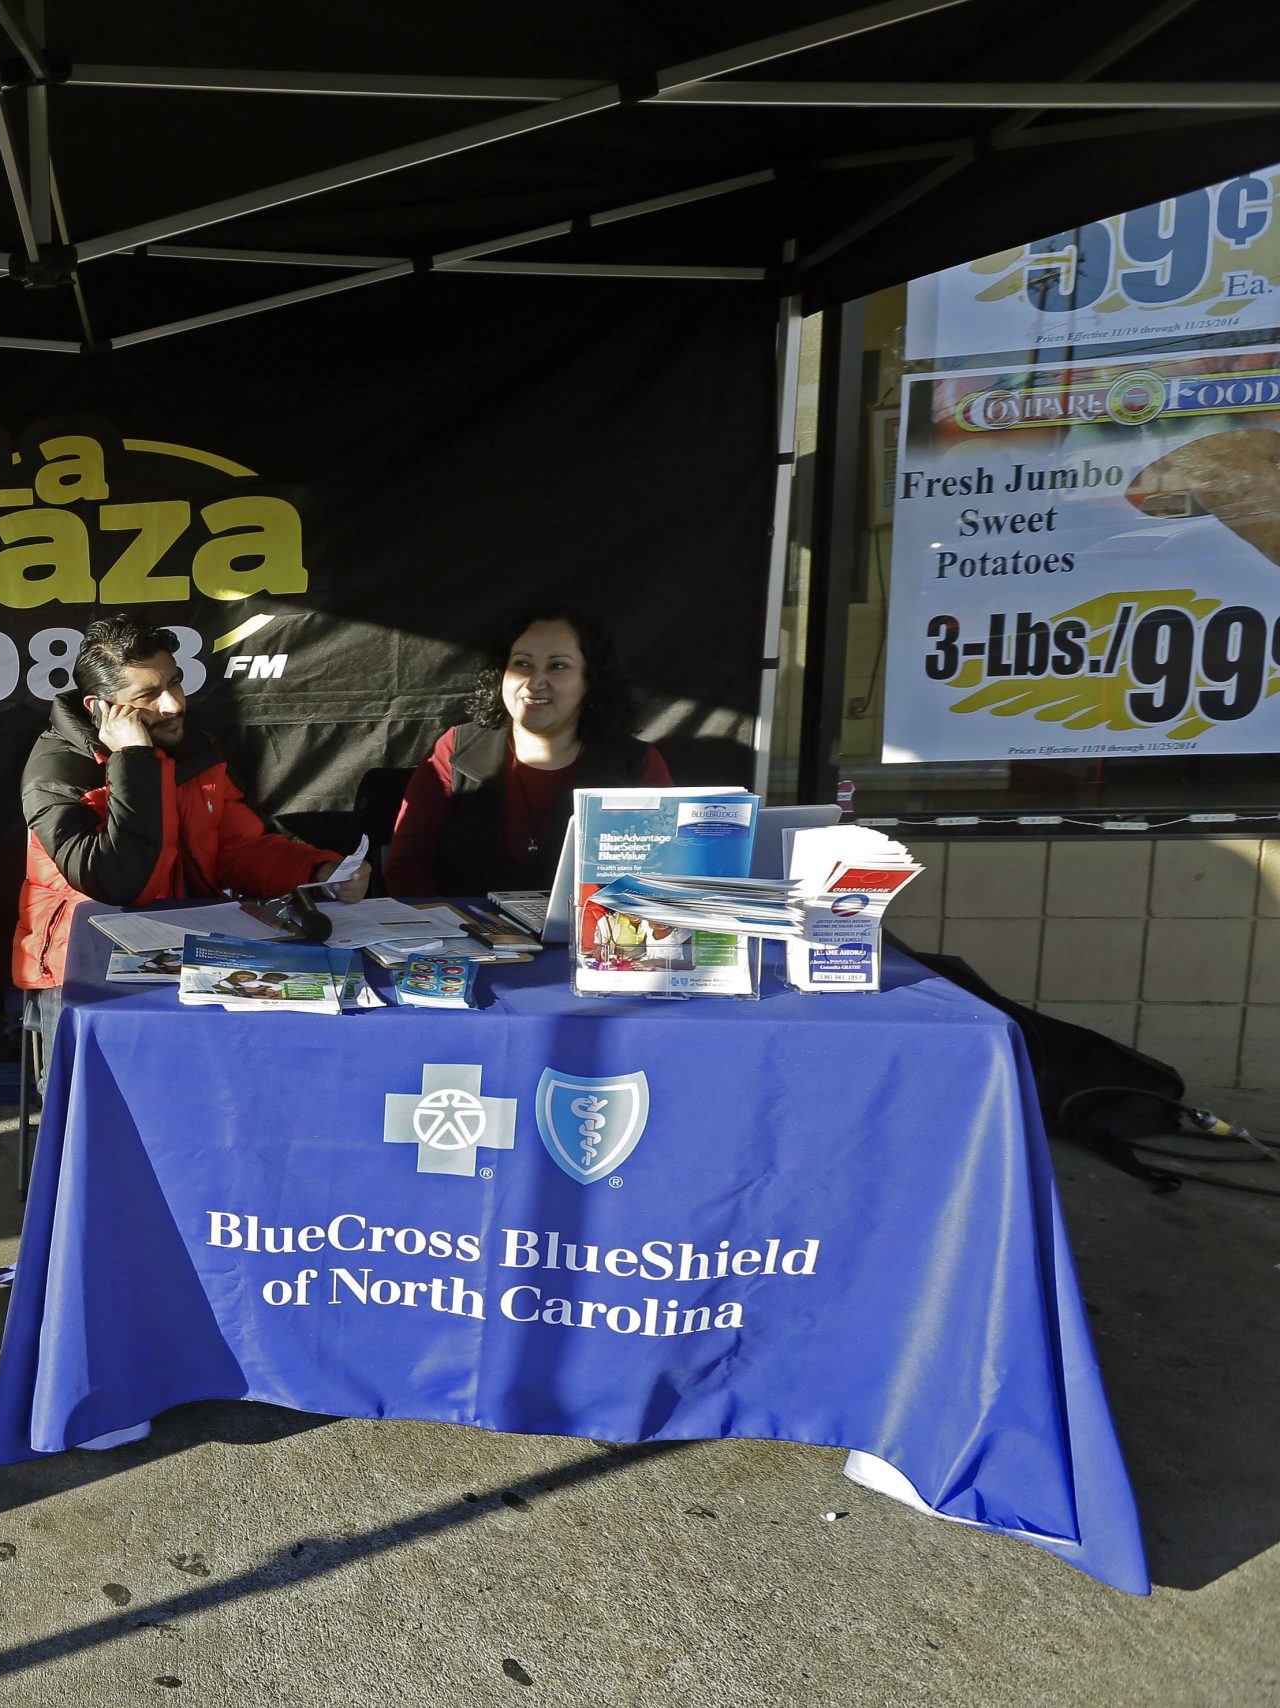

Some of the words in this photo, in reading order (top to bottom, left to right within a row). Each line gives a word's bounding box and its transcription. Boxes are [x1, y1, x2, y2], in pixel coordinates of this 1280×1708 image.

[1226, 273, 1273, 298] Ea.
[1036, 331, 1065, 344] Prices
[1067, 329, 1109, 342] Effective
[1111, 326, 1139, 338] 11/19
[1140, 322, 1182, 336] through
[969, 390, 1106, 430] COMPARE
[899, 467, 994, 500] Fresh
[1005, 459, 1124, 493] Jumbo
[959, 507, 1058, 537] Sweet
[935, 551, 1075, 579] Potatoes
[223, 654, 289, 679] FM
[1008, 746, 1037, 756] Prices
[1038, 744, 1080, 756] Effective
[599, 833, 672, 844] BlueAdvantage
[599, 843, 651, 852] BlueSelect
[598, 851, 647, 861] BlueValue
[205, 1210, 483, 1263] BlueCross
[498, 1228, 820, 1283] BlueShield
[262, 1268, 317, 1306] of
[327, 1267, 487, 1320] North
[499, 1285, 745, 1338] Carolina
